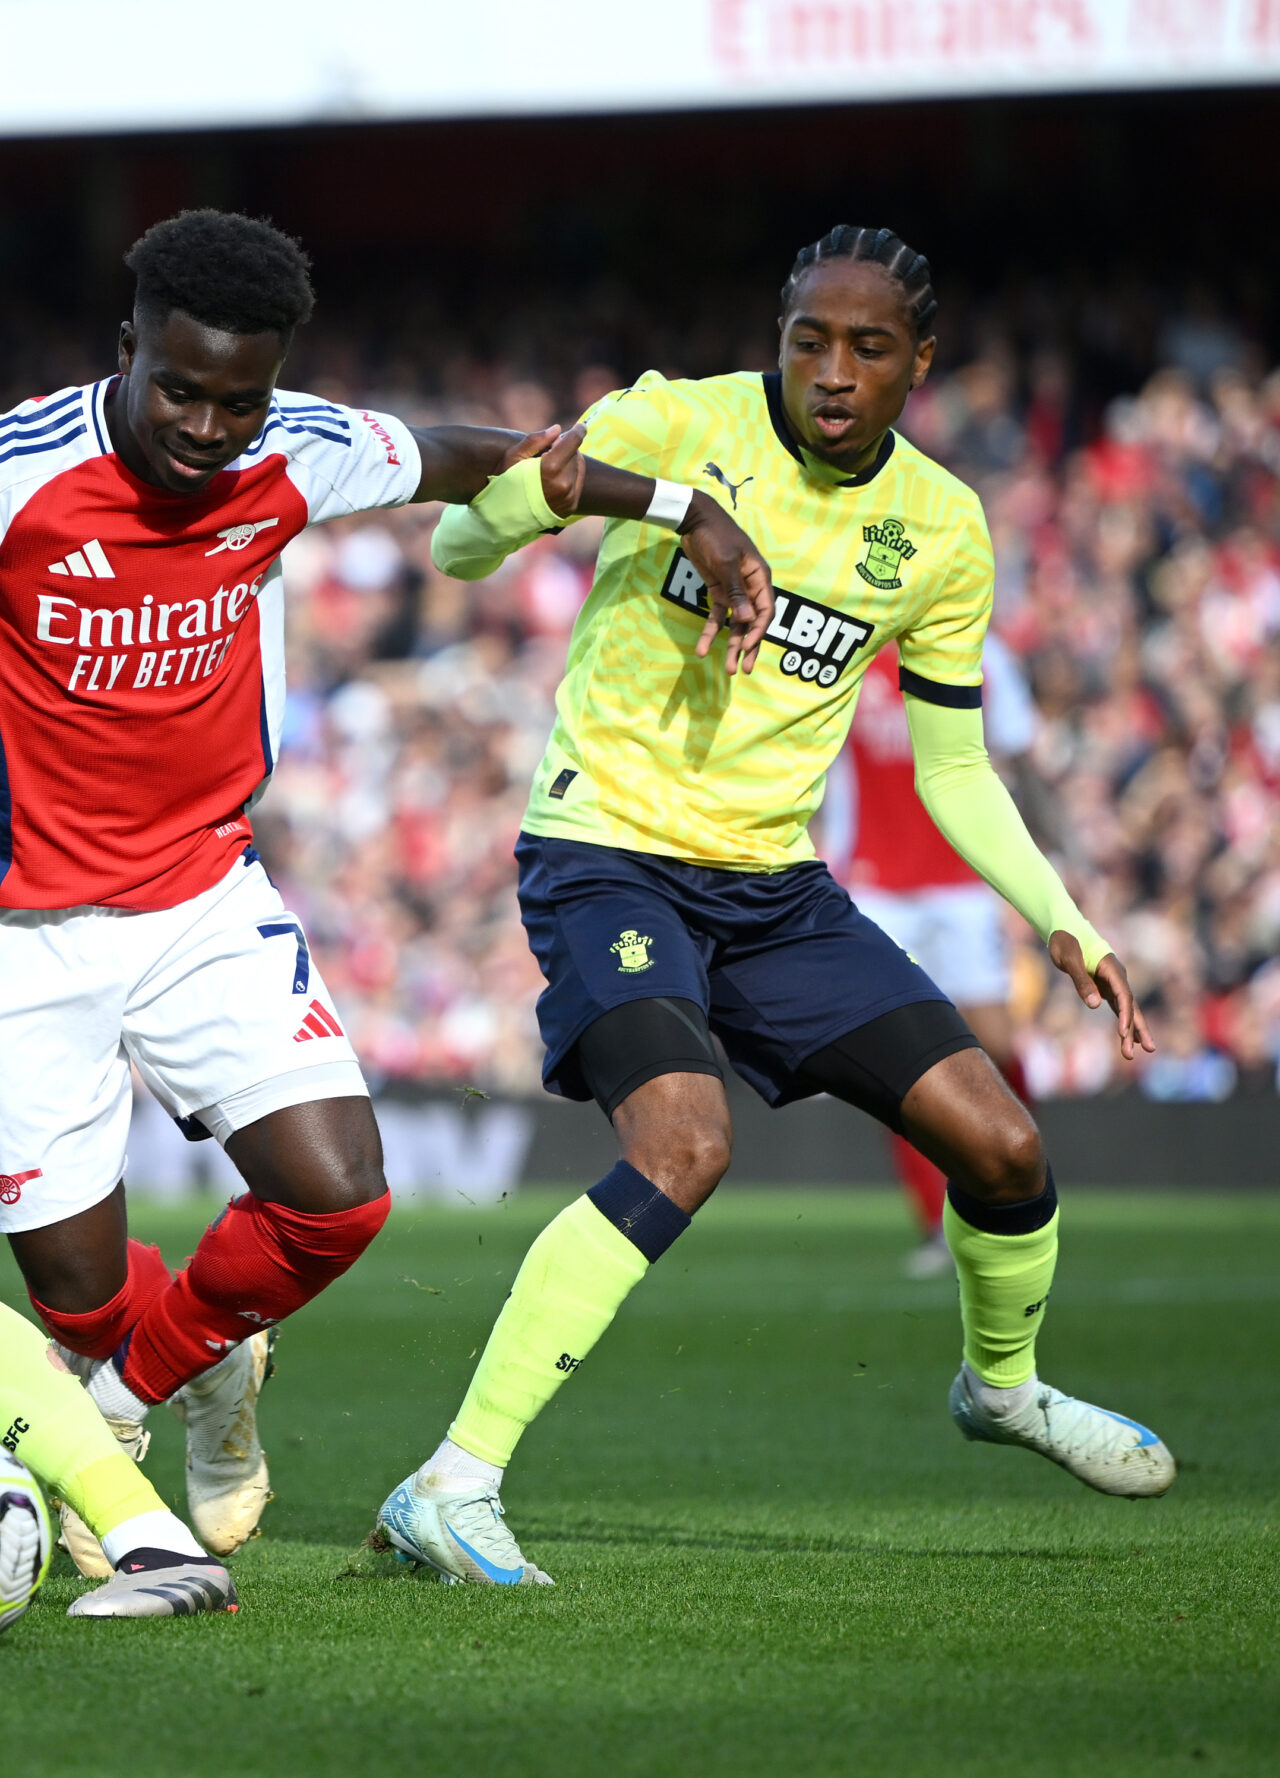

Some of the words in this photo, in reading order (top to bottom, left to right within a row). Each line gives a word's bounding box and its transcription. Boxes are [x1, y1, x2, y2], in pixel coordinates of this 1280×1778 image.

[667, 556, 867, 662] RLBIT
[67, 654, 128, 691] FLY
[256, 923, 309, 994] 7
[2, 1416, 30, 1453] SFC
